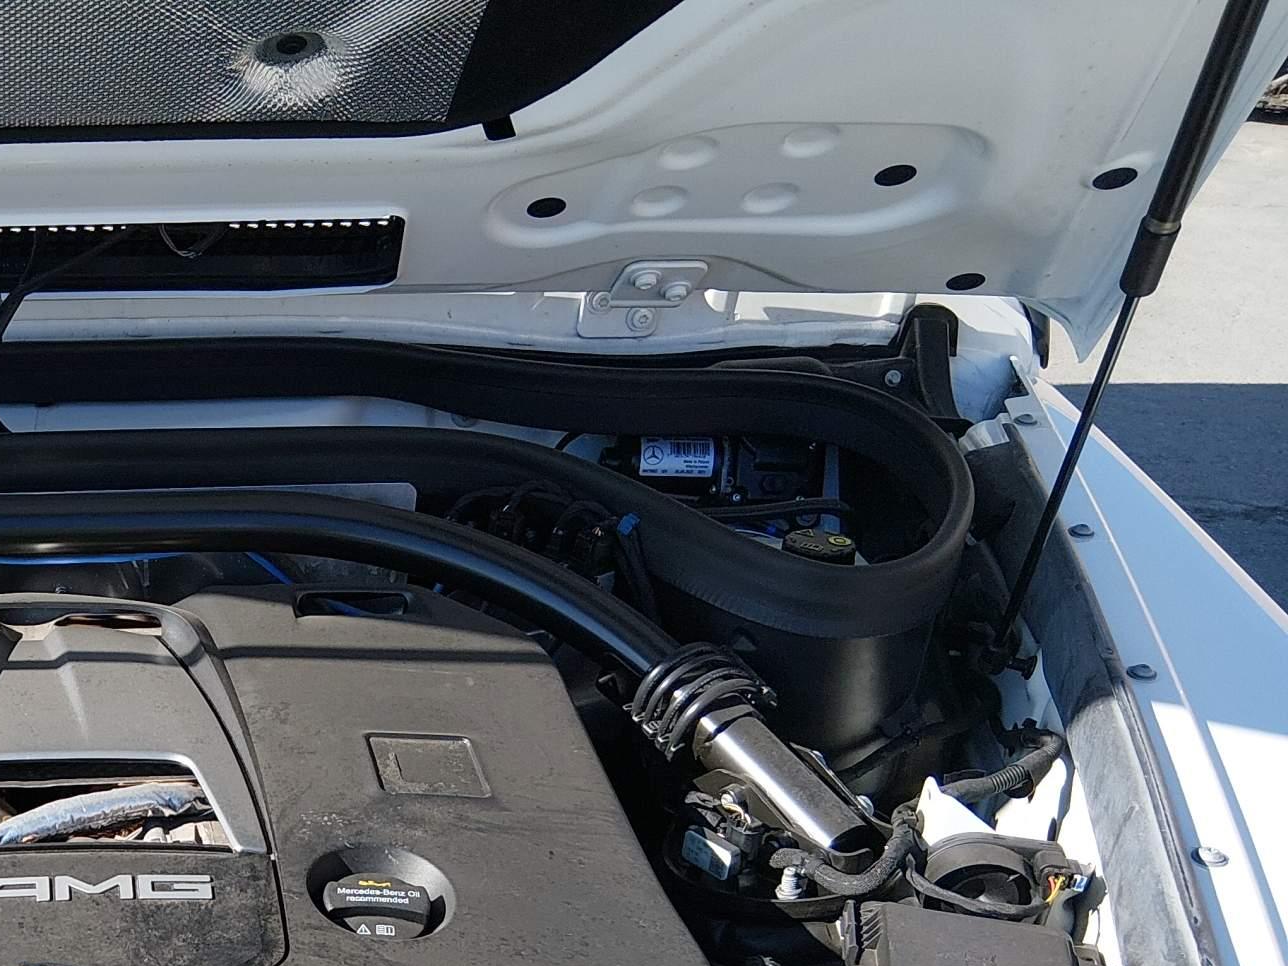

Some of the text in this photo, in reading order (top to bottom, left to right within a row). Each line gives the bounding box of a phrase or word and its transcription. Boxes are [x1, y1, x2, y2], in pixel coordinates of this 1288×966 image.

[337, 887, 420, 898] Mercedes-Benz Oil
[346, 895, 410, 904] recommended
